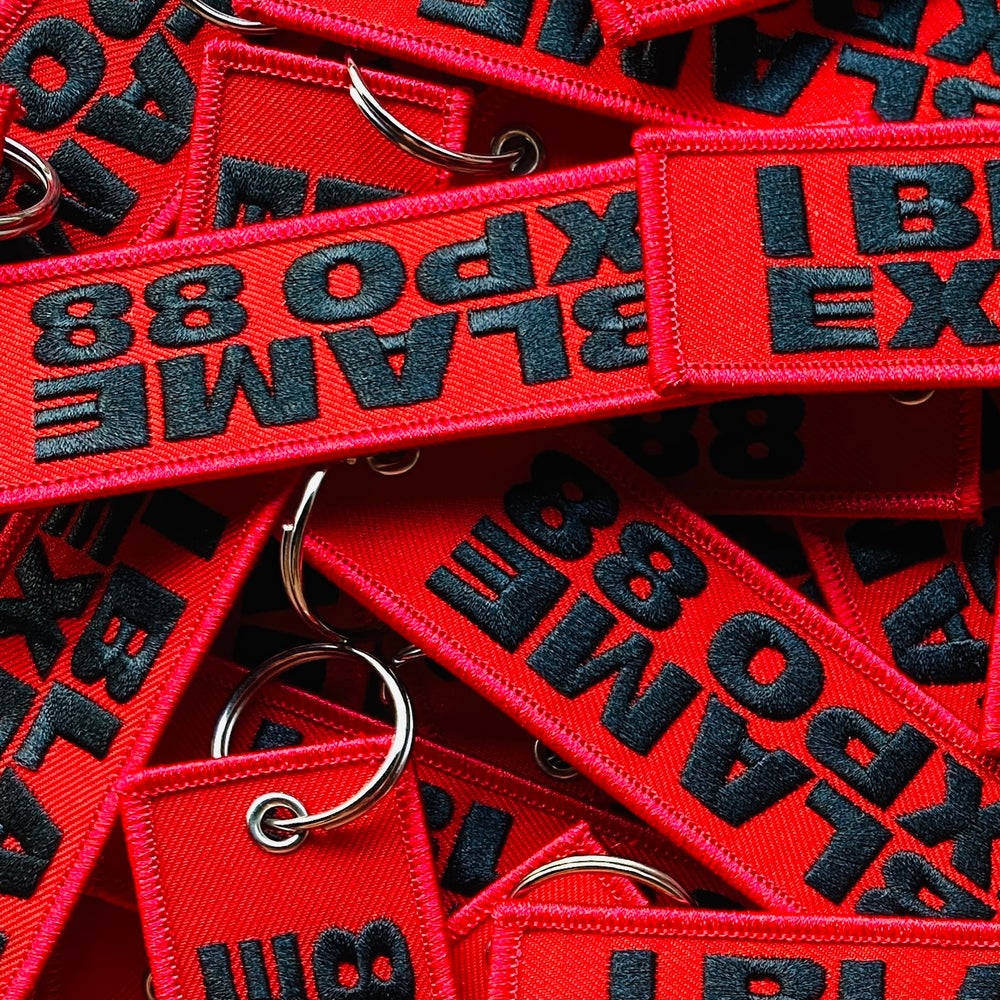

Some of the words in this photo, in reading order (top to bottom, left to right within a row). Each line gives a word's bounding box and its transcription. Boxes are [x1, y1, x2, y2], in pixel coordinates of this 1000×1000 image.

[282, 190, 642, 324] XPO
[756, 164, 814, 258] I
[30, 263, 247, 366] 88
[503, 449, 708, 632] 88
